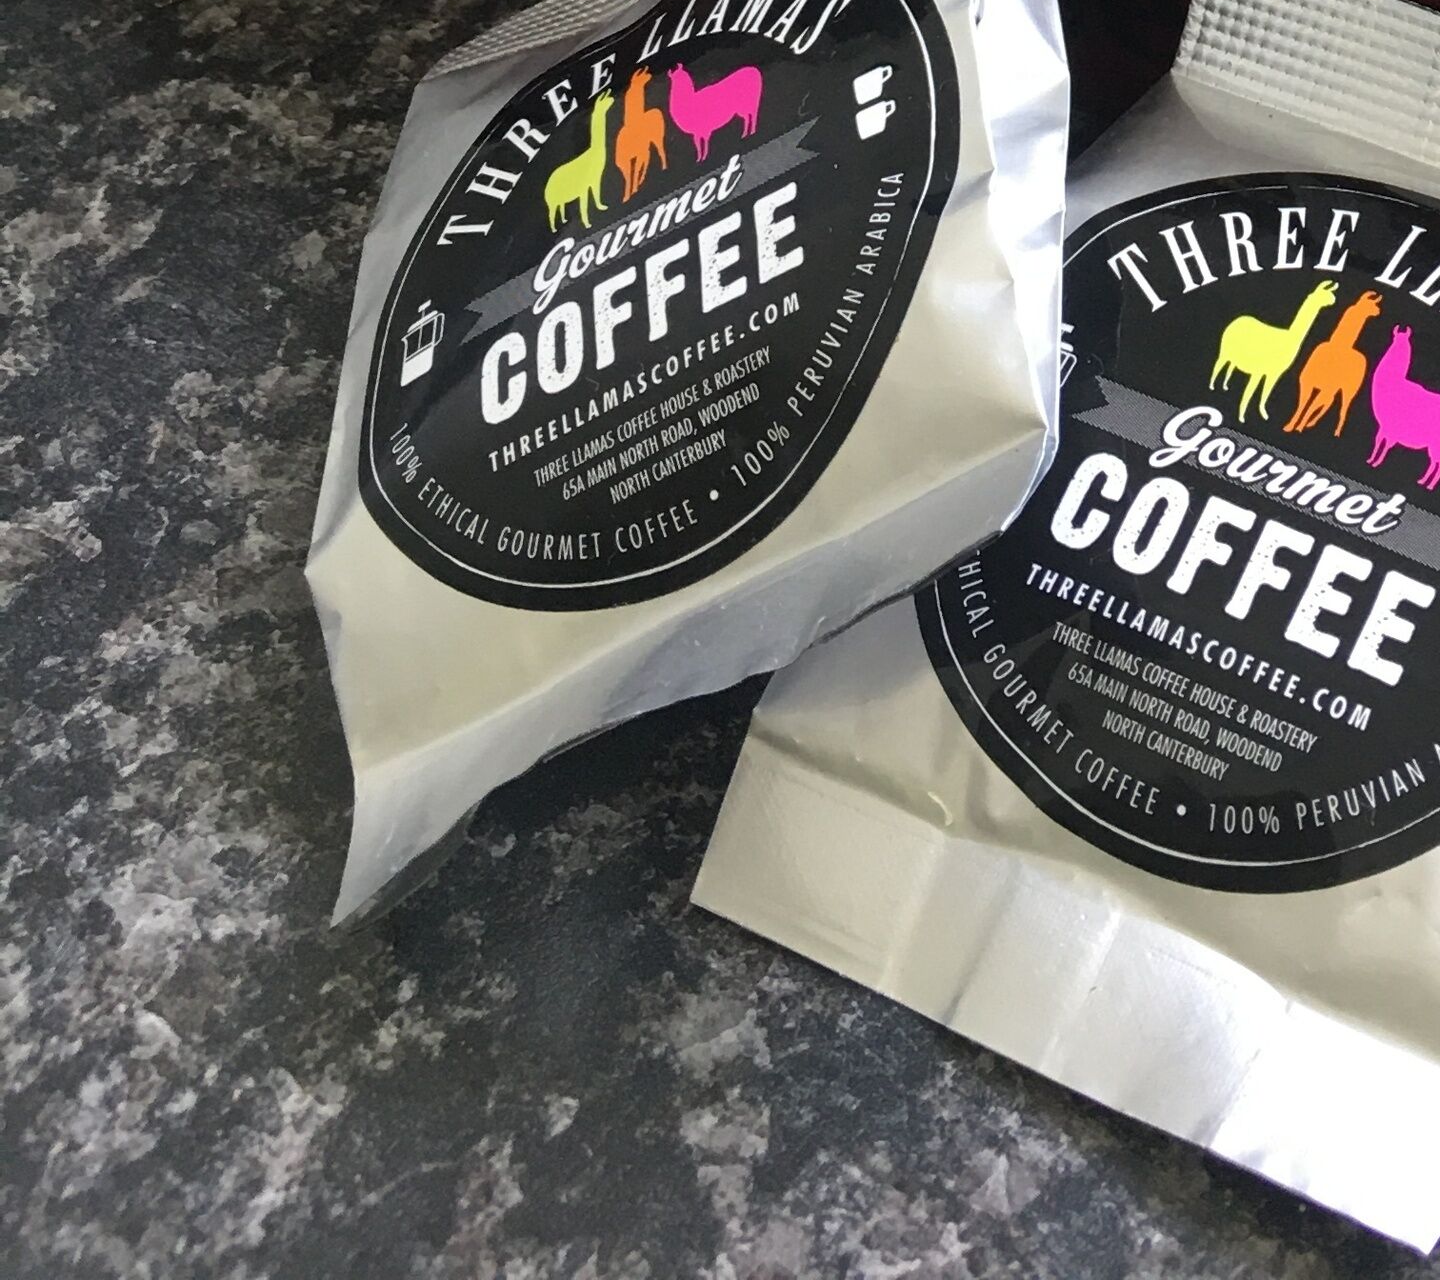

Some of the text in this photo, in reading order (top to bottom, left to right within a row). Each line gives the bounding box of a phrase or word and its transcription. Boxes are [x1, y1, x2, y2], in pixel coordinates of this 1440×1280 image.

[437, 53, 616, 245] THREE
[480, 182, 804, 425] COFFEE
[532, 154, 743, 314] Gourmet
[1106, 207, 1360, 313] THREE
[390, 172, 904, 561] 100% ETHICAL GOURMET COFFEE 100% PERUVIAN ARABICA
[489, 292, 799, 473] THREELLAMASCOFFEE.COM
[533, 346, 773, 488] THREE LLAMAS COFFEE HOUSE & ROASTERY
[561, 382, 761, 501] 65A MAIN NORTH ROAD, WOODEND
[608, 428, 727, 505] NORTH CANTERBURY
[1148, 406, 1406, 534] Gourmet
[1050, 452, 1436, 687] COFFEE
[957, 549, 995, 638] HICAL
[982, 644, 1074, 755] GOURMET
[1074, 748, 1161, 815] COFFEE
[1209, 803, 1280, 835] 100%
[1296, 758, 1427, 830] PERUVIAN
[1026, 563, 1372, 731] THREELLAMASCOFFEE.COM
[1052, 621, 1318, 754] THREE LLAMAS COFFEE HOUSE & ROASTERY
[1068, 662, 1284, 773] 65A MAIN NORTH ROAD, WOODEND
[1101, 709, 1230, 782] NORTH CANTERBURY
